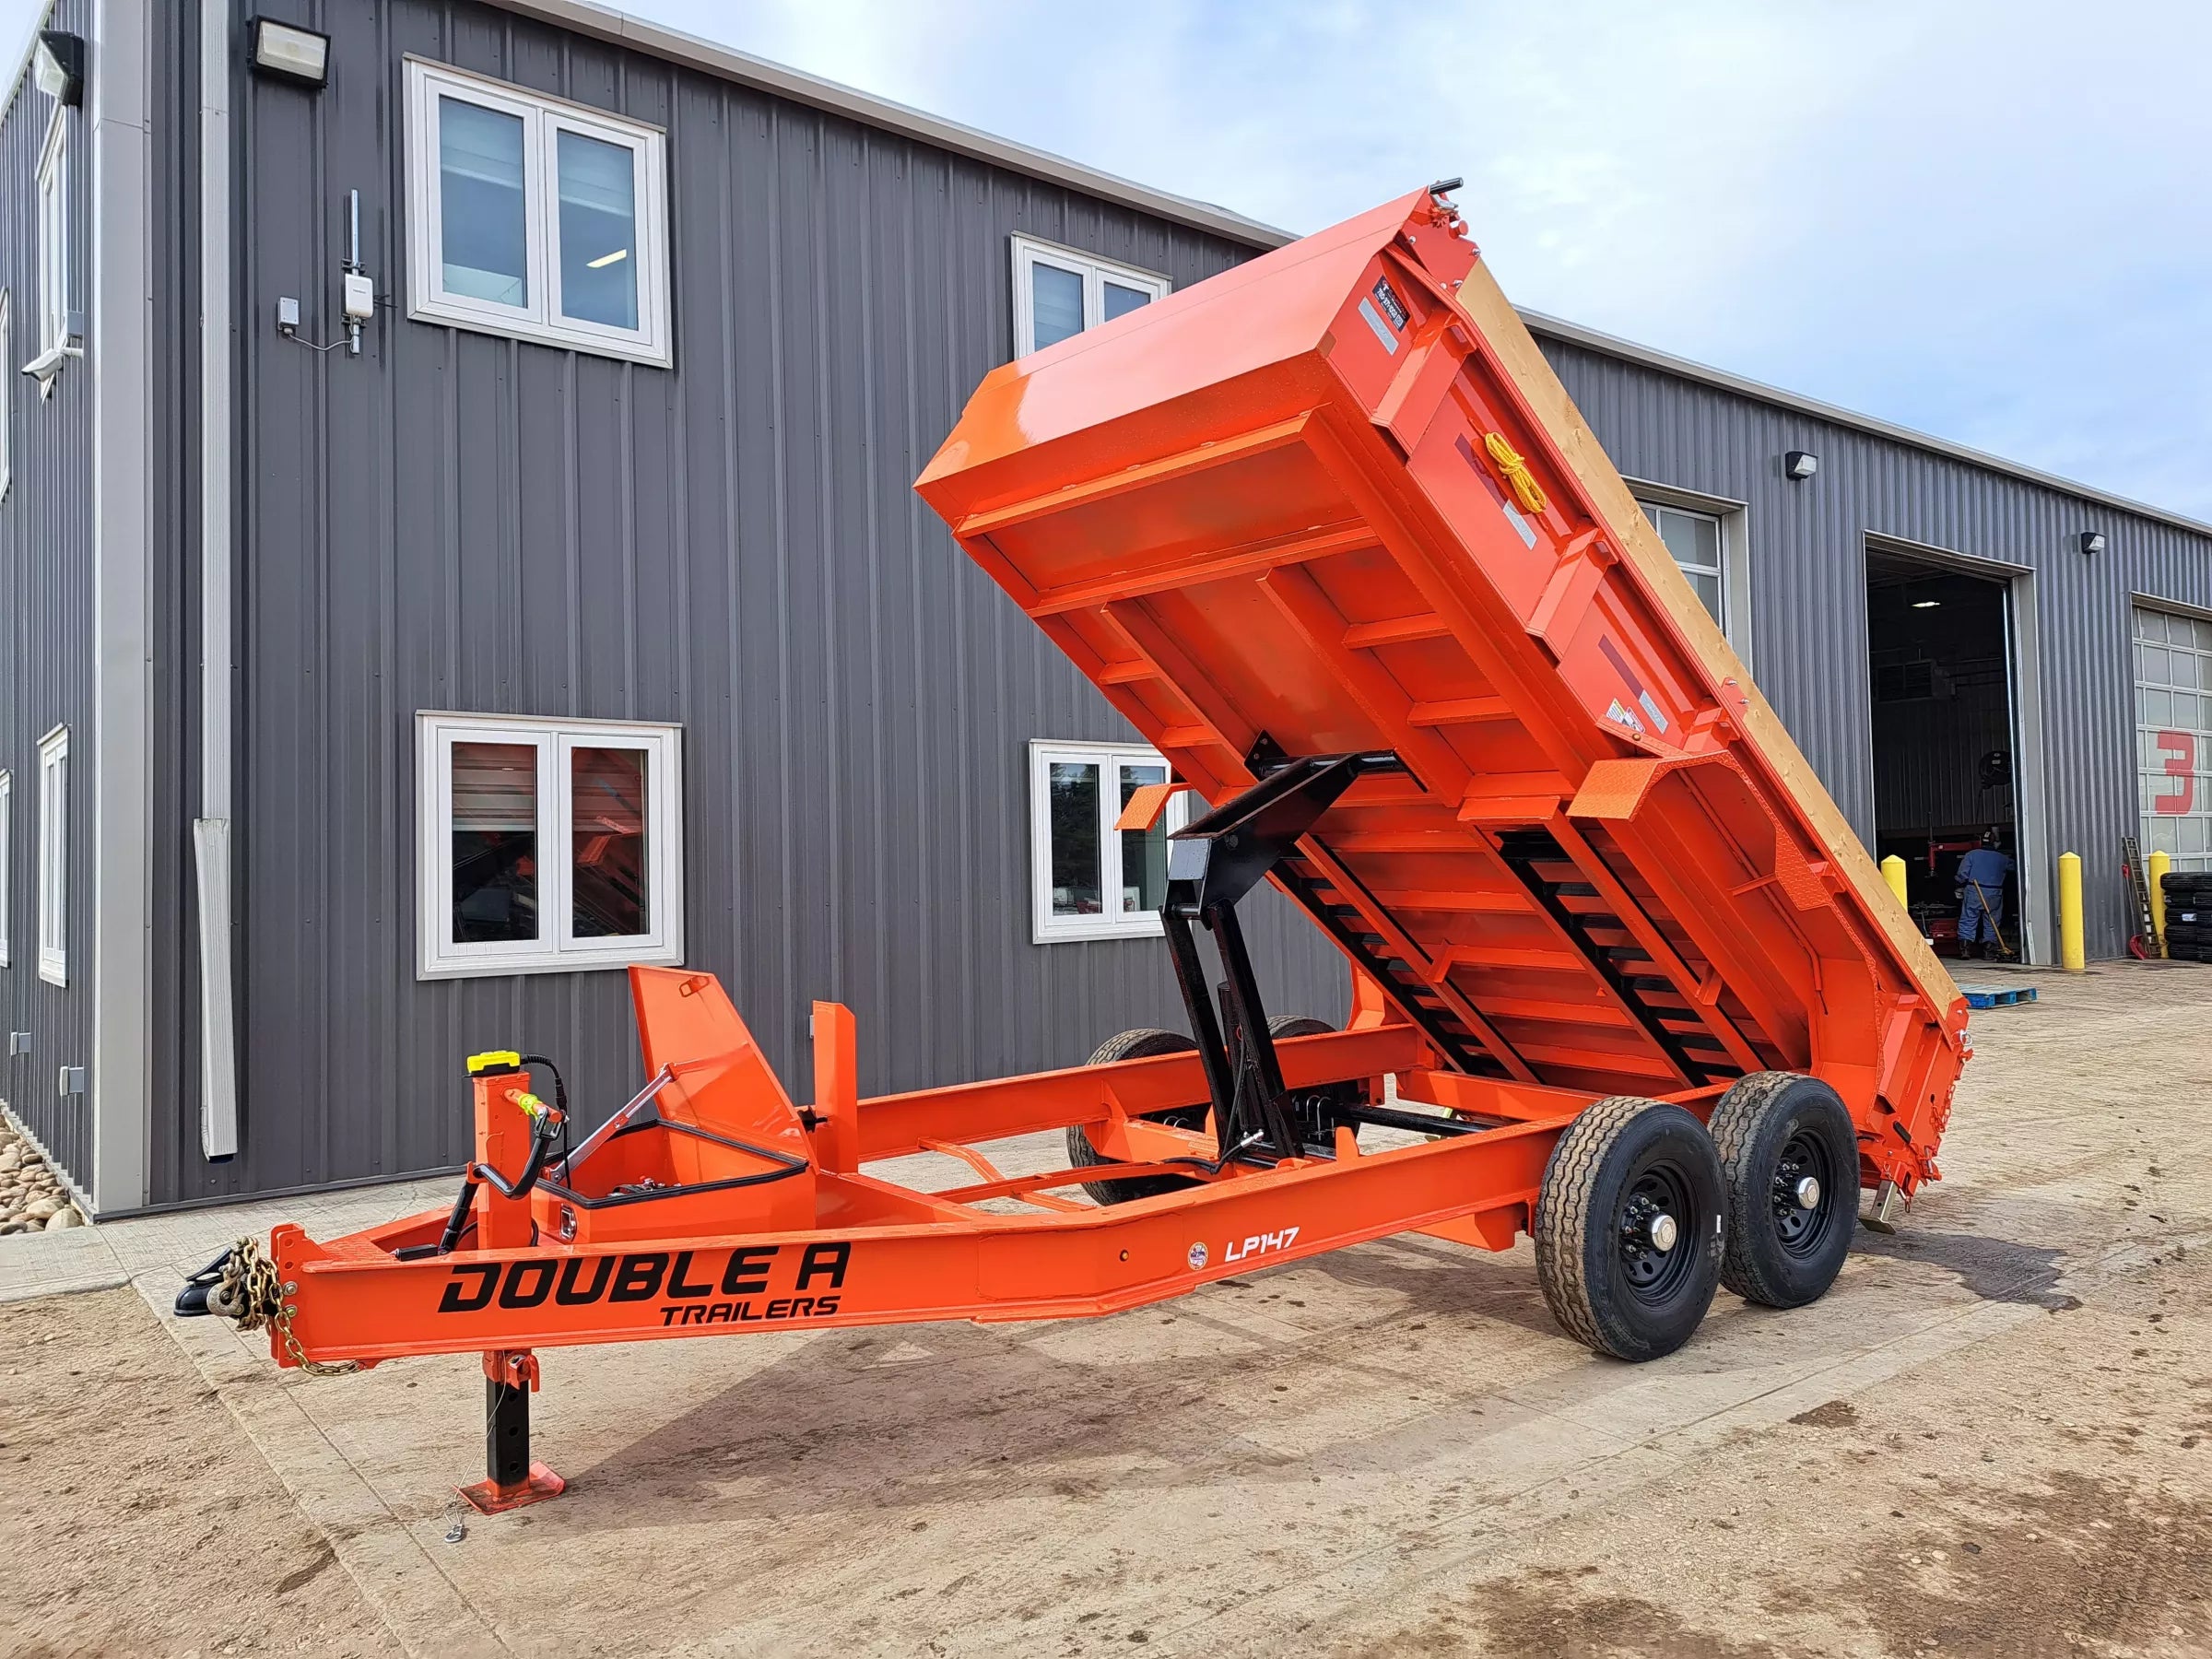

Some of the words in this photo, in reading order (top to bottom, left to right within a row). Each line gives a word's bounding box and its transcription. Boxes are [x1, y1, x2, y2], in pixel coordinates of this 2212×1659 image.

[2155, 729, 2194, 815] 3
[1224, 1226, 1300, 1262] LP147
[437, 1246, 780, 1312] DOUBLE
[795, 1241, 851, 1290] A
[660, 1296, 841, 1326] TRAILERS
